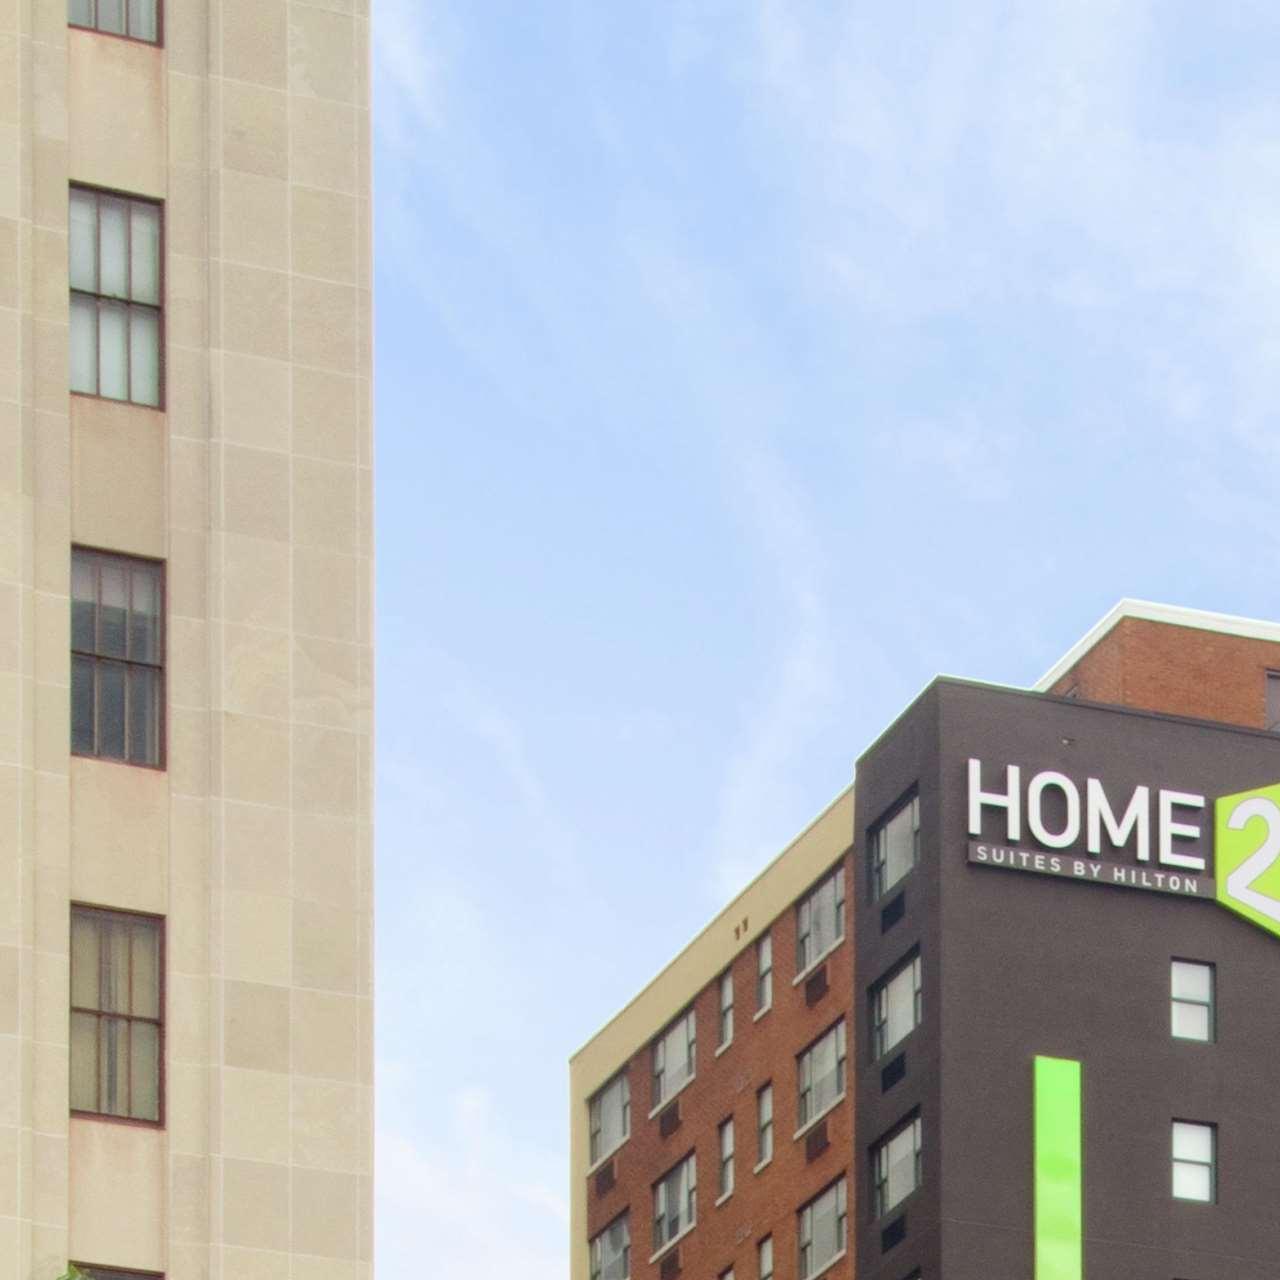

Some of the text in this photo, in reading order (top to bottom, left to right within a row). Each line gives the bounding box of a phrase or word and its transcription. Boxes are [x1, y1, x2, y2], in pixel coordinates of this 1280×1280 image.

[968, 758, 1206, 870] HOME
[976, 845, 1199, 894] SUITES BY HILTON
